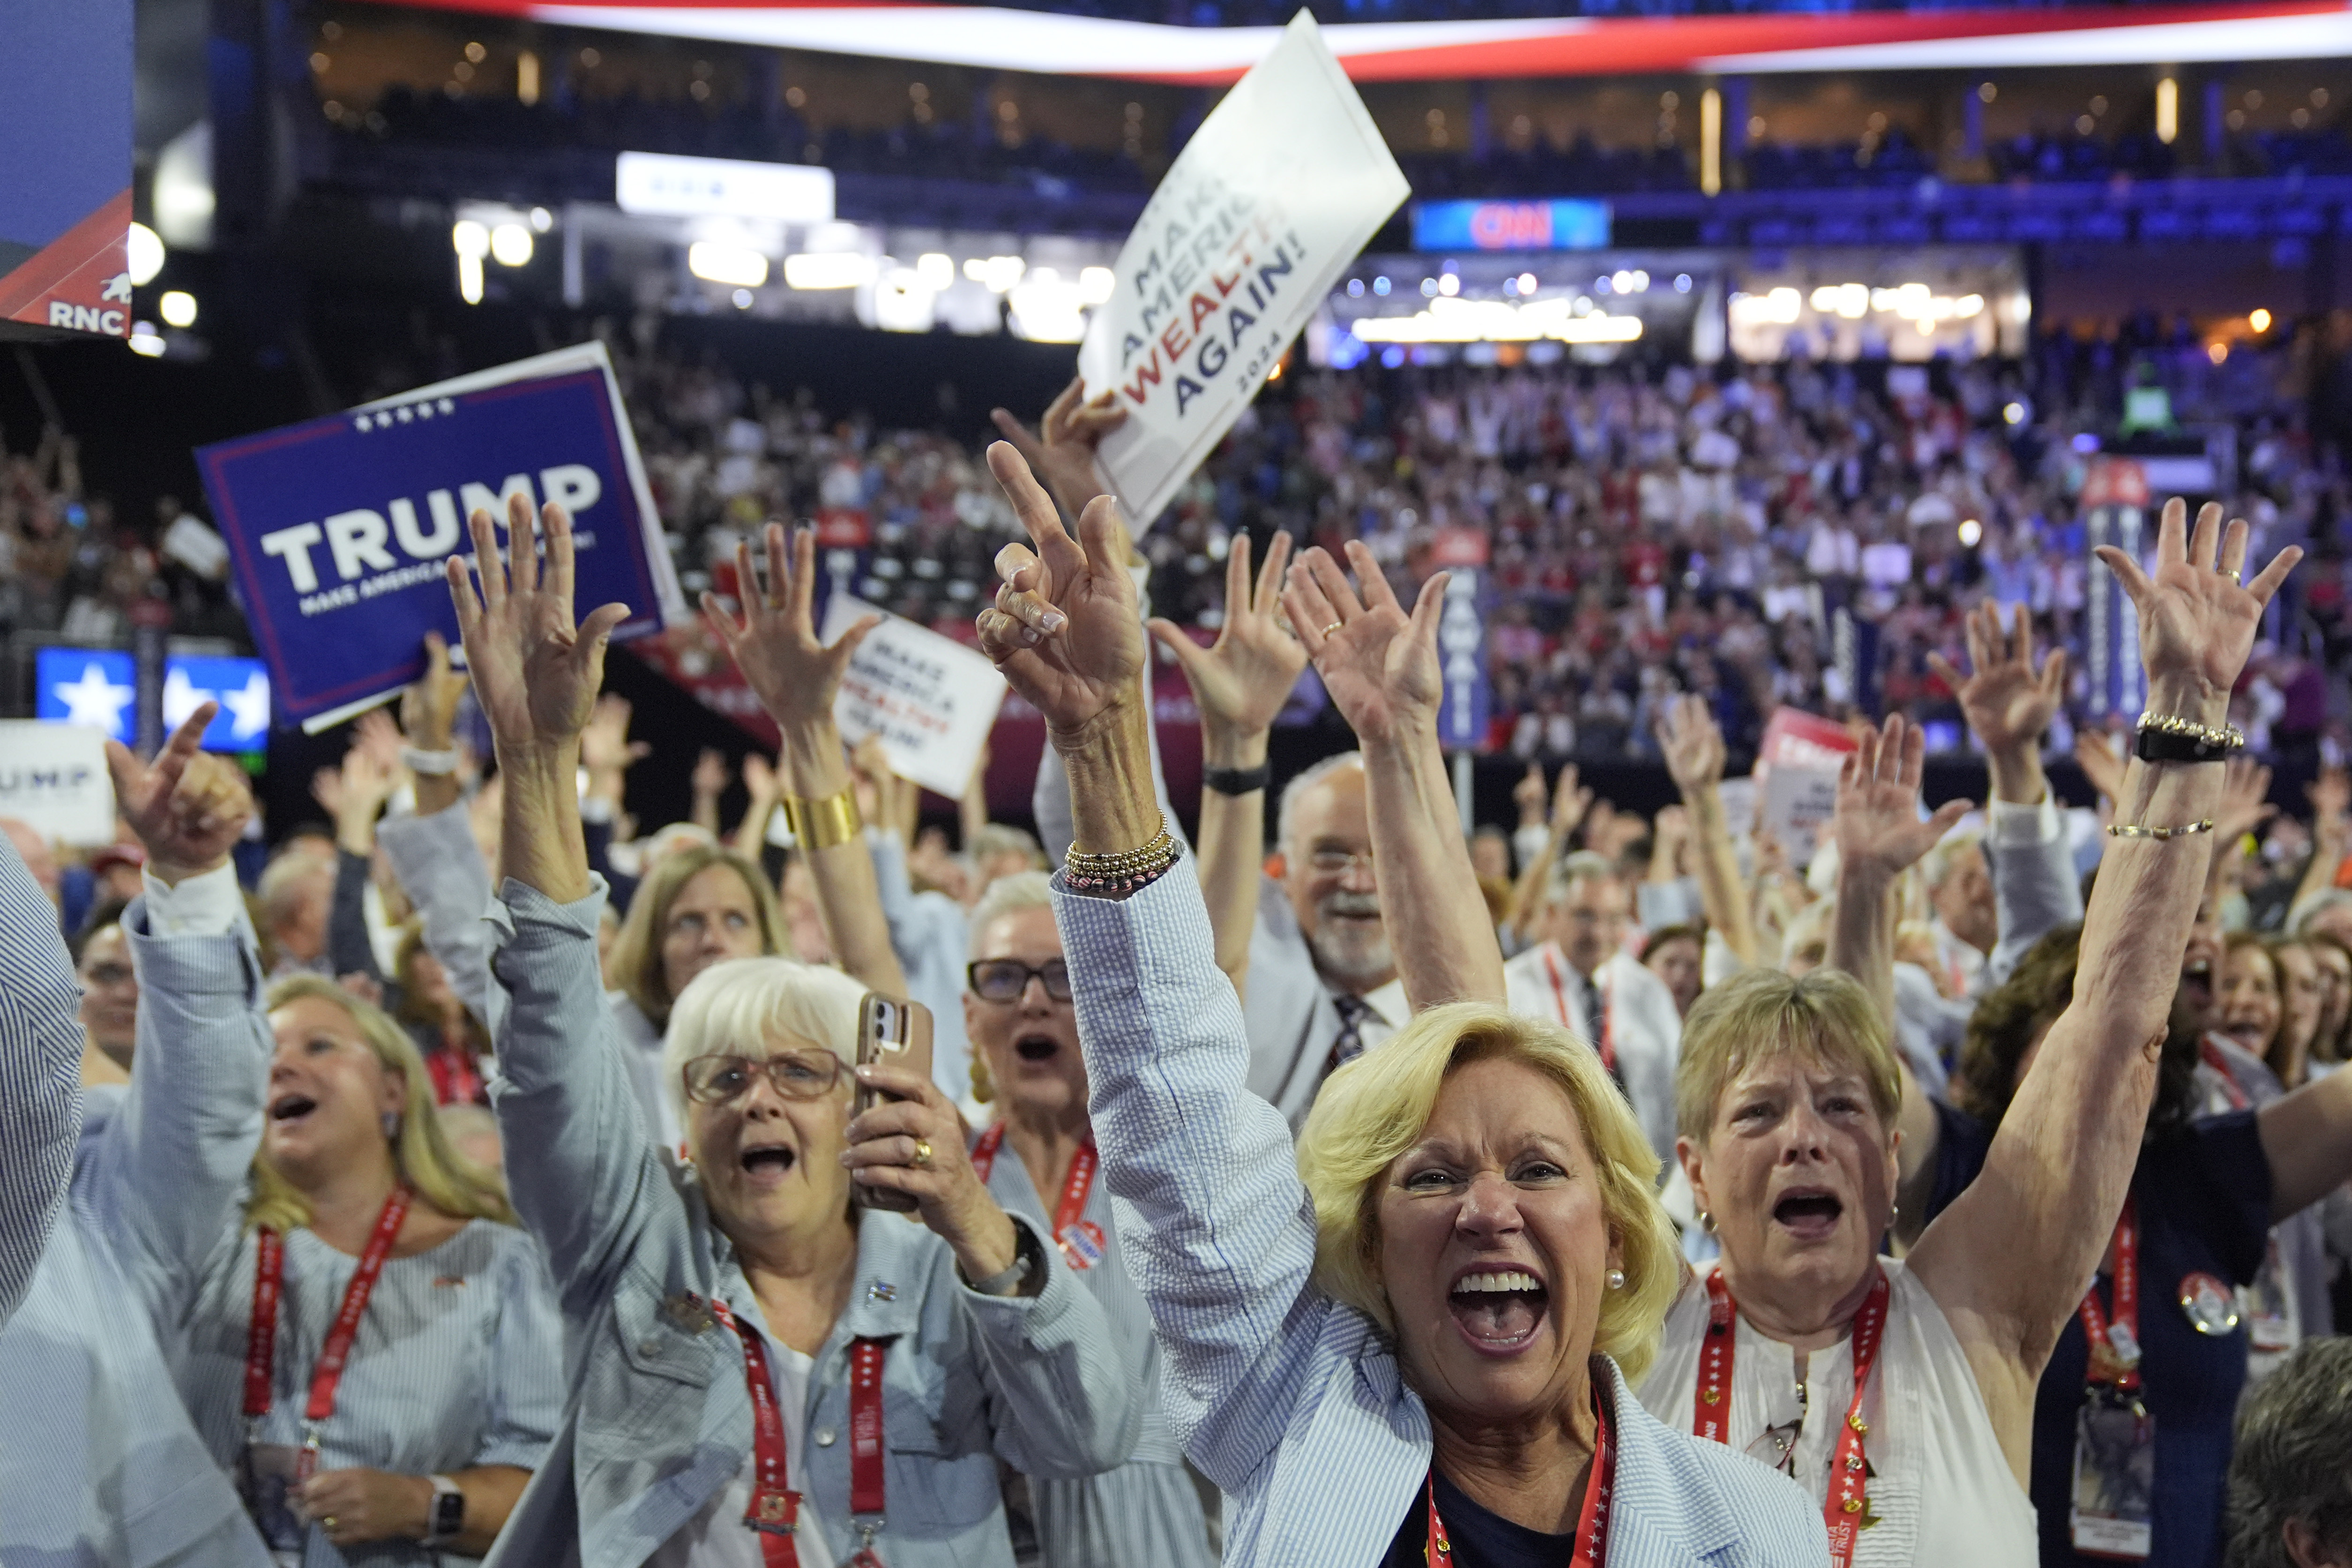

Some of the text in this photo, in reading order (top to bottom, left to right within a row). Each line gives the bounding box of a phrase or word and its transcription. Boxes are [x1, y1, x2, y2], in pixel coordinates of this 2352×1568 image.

[1470, 202, 1553, 249] CNN
[49, 301, 125, 336] RNC
[1172, 229, 1307, 418] AGAIN!
[1235, 331, 1282, 394] 2024
[261, 463, 603, 594] TRUMP
[1833, 1519, 1852, 1554] TRUST
